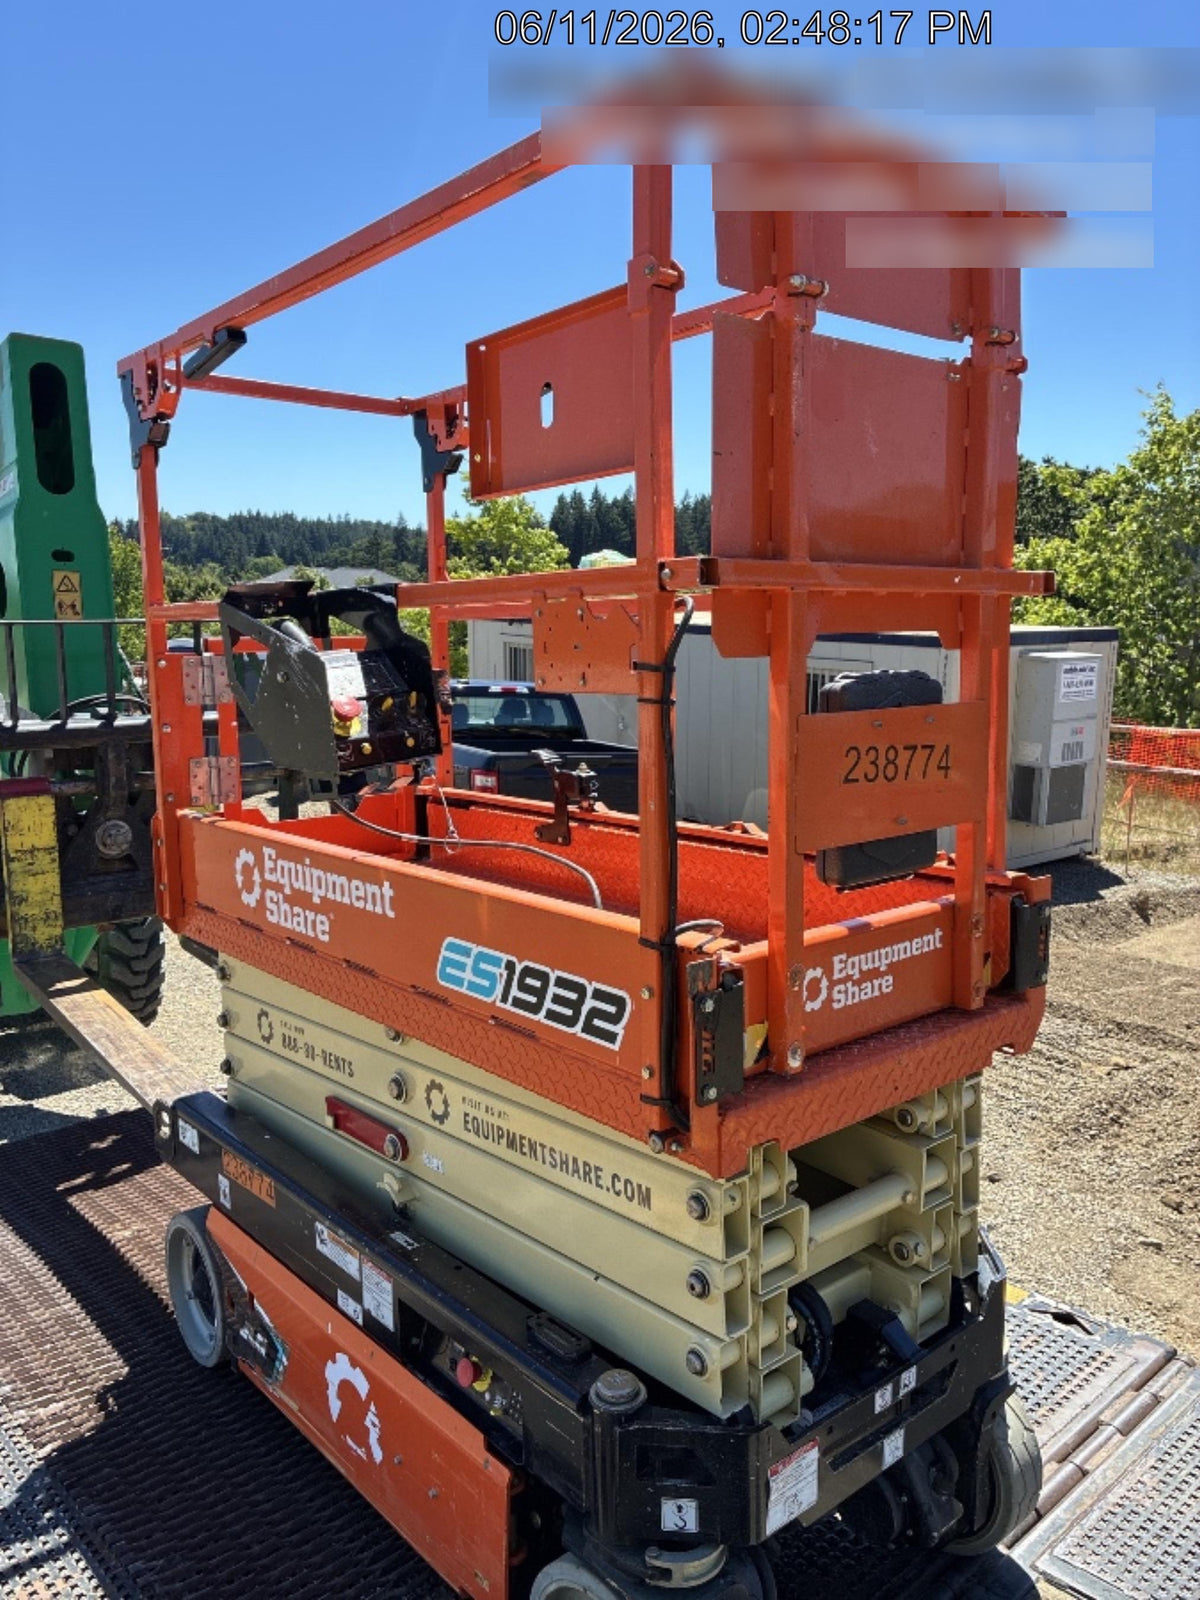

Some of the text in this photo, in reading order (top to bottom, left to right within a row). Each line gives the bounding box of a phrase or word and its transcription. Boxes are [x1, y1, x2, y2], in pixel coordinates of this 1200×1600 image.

[842, 744, 950, 784] 238774
[262, 845, 395, 918] Equipment
[265, 888, 330, 943] Share
[832, 927, 943, 980] Equipment
[436, 936, 632, 1051] ES1932
[832, 973, 894, 1010] Share
[463, 1111, 652, 1211] EQUIPMENTSHARE.COM
